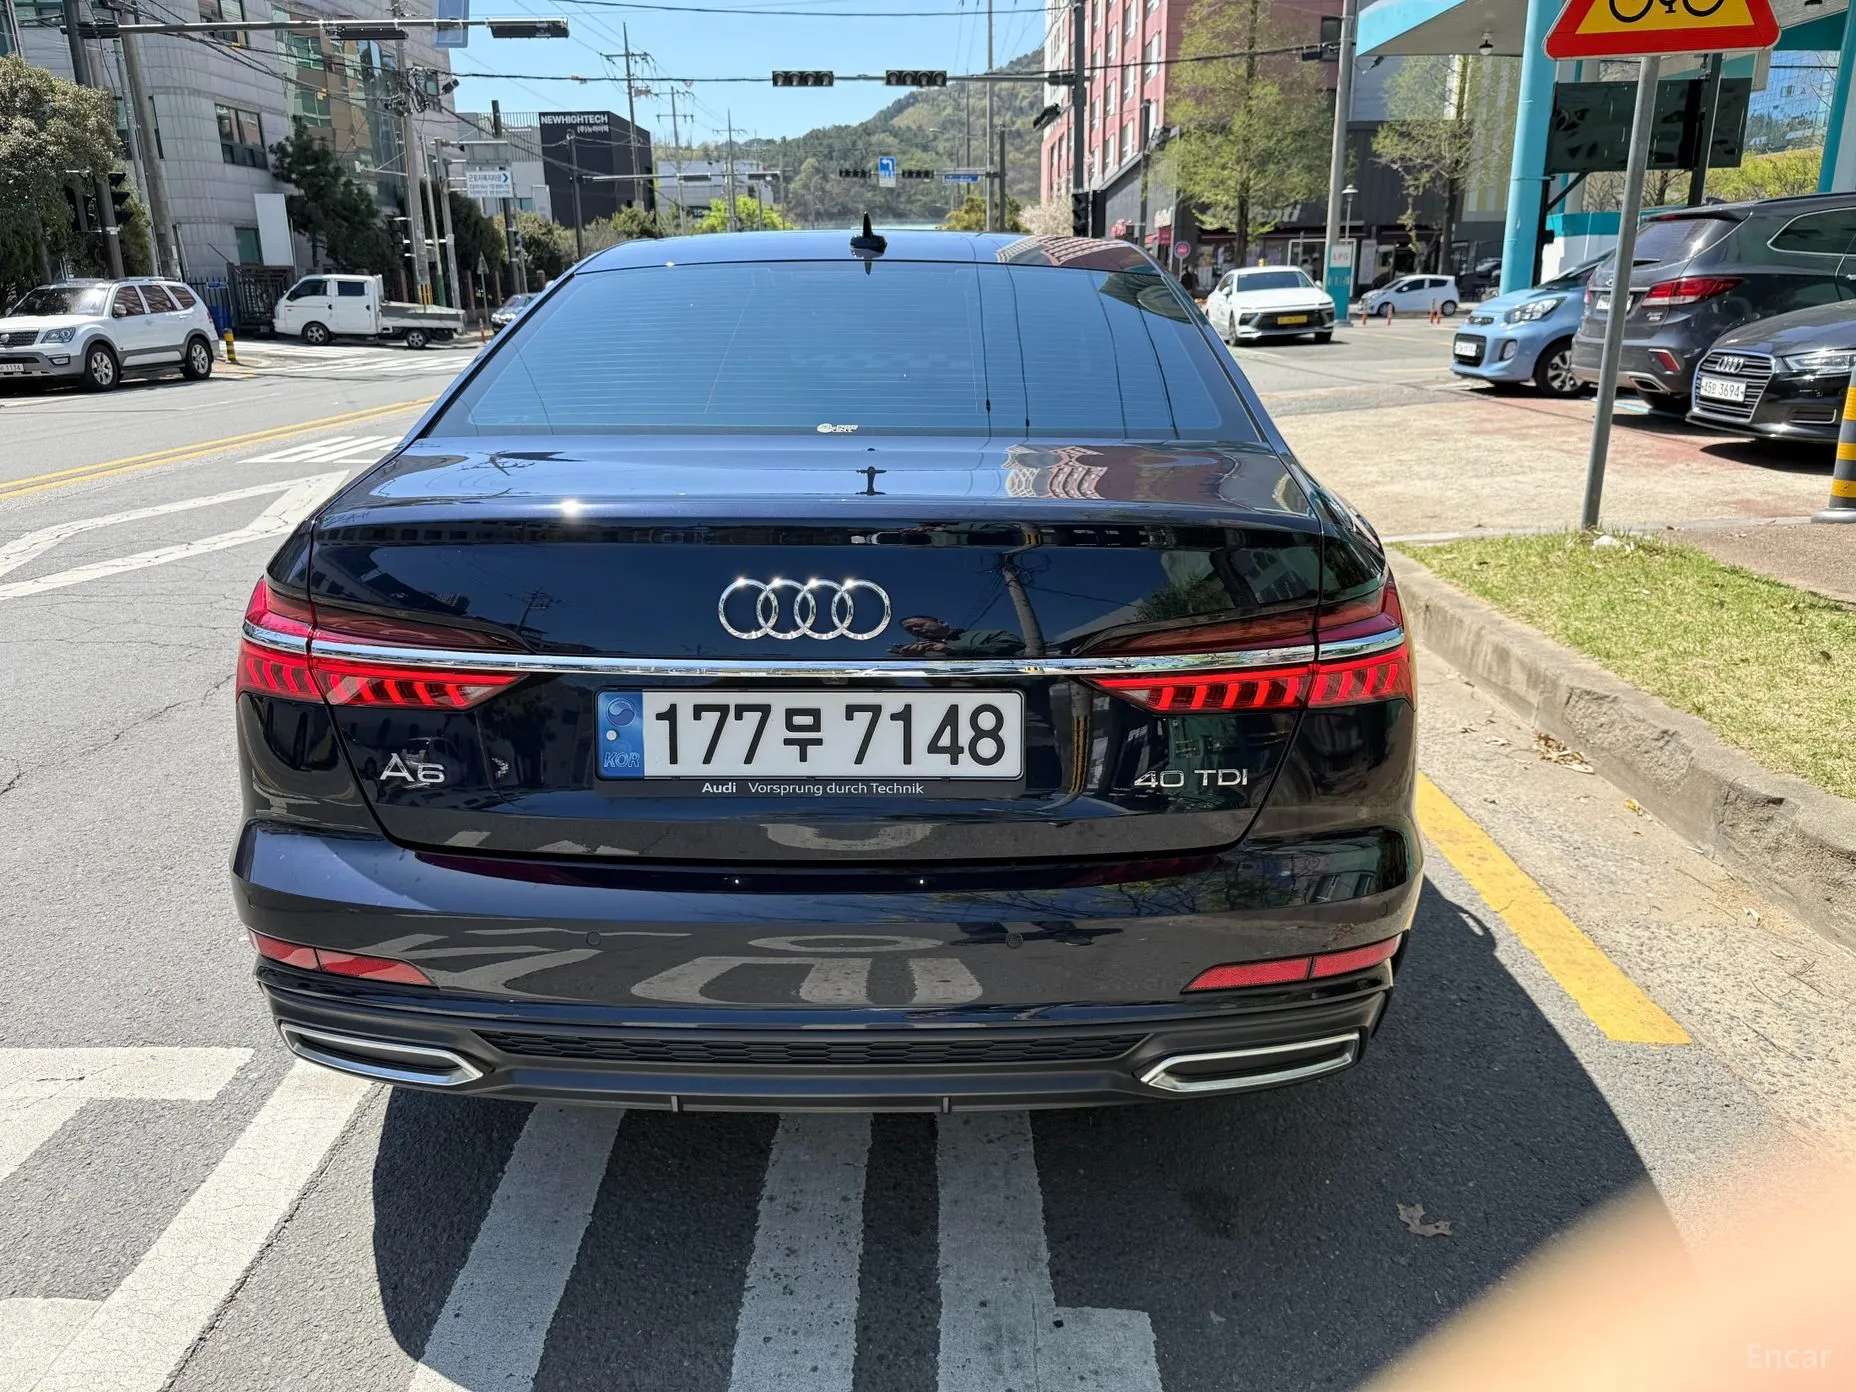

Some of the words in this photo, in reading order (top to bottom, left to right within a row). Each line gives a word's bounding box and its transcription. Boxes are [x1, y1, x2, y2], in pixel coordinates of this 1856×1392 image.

[541, 114, 608, 124] NEWHIGHTECH
[1718, 383, 1740, 398] 3694
[655, 703, 823, 765] 177무
[845, 703, 1006, 766] 7148
[379, 752, 445, 783] A6
[603, 752, 640, 768] KOR
[1134, 770, 1185, 788] 40
[1194, 768, 1248, 786] TDI
[702, 782, 737, 793] Audi
[748, 782, 823, 796] Vorsprung
[826, 782, 867, 794] durch
[870, 782, 925, 794] Technik
